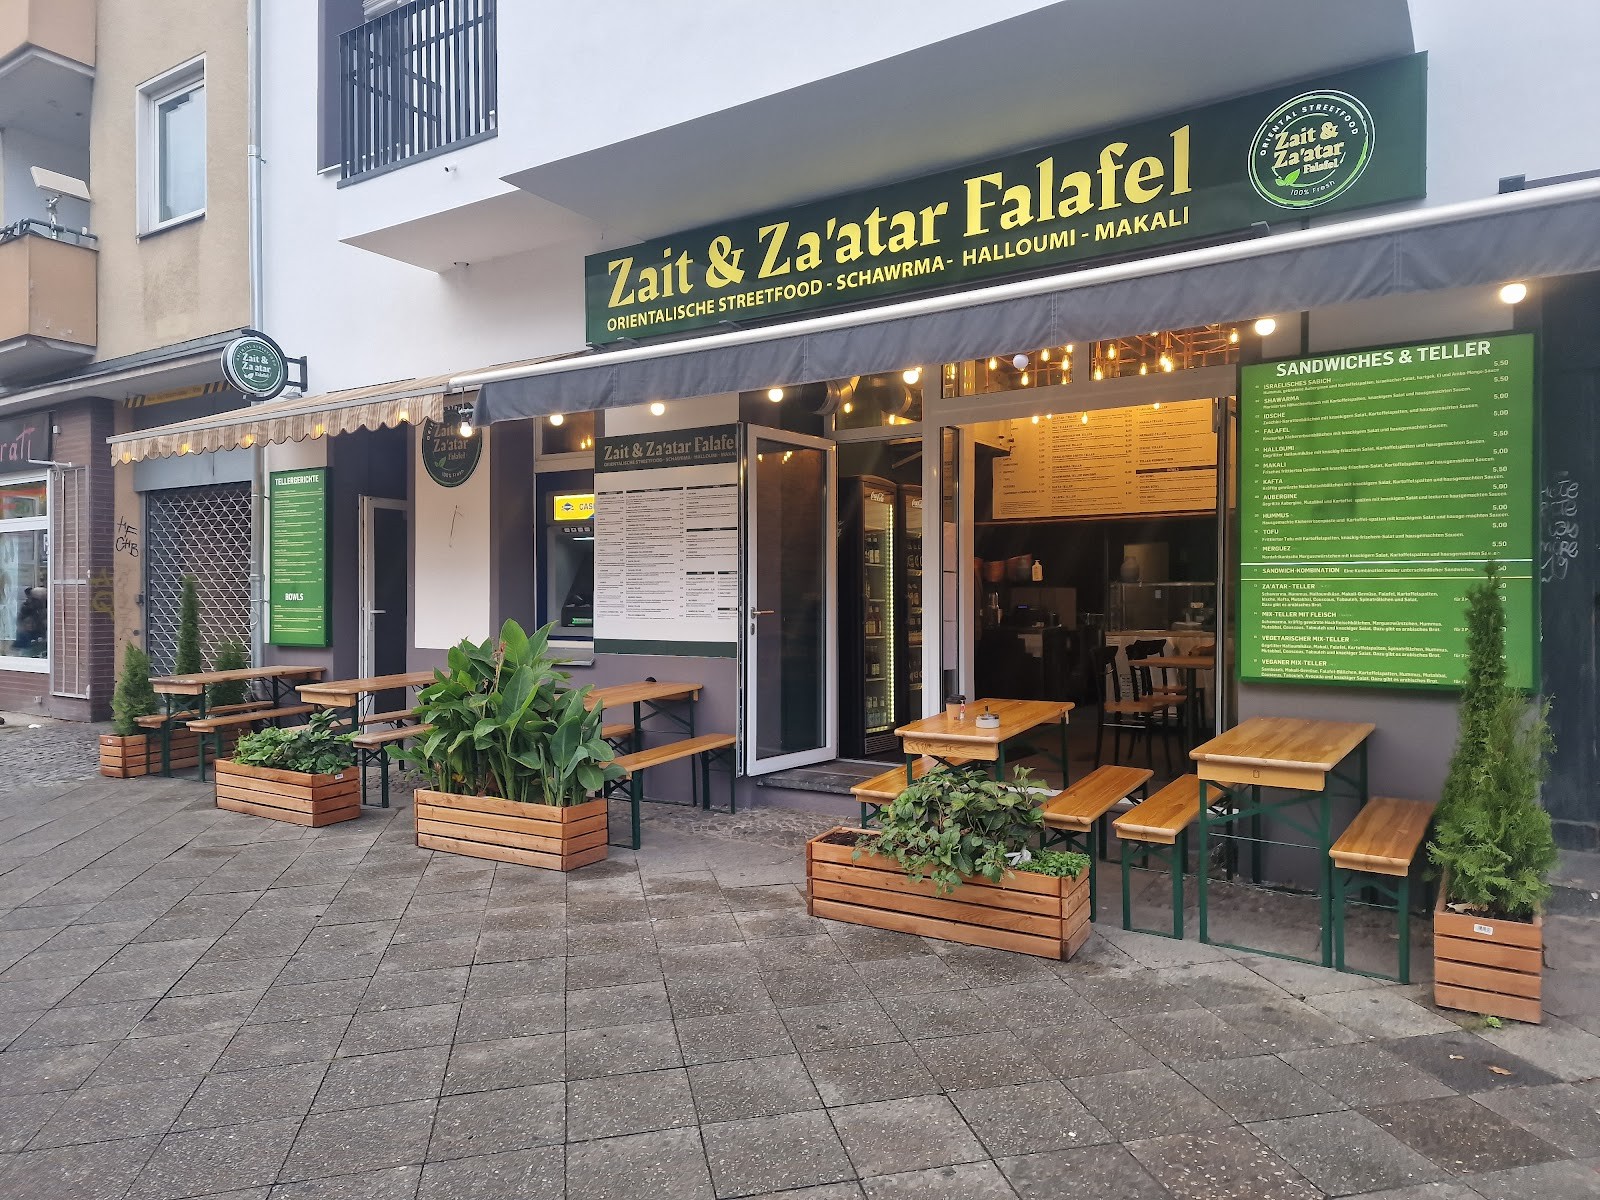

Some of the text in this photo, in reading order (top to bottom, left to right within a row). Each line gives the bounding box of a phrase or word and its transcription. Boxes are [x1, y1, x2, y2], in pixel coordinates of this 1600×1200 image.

[1260, 104, 1359, 156] ORIENTAL STREETFOOD
[1275, 122, 1338, 150] Zait &
[1272, 142, 1345, 168] Za'atar
[1303, 158, 1339, 174] Falafel
[1312, 180, 1336, 193] Fresh
[608, 124, 1192, 308] Zait & Za'atar Falafel
[607, 299, 715, 332] ORIENTALISCHE
[719, 279, 823, 312] STREETFOOD
[963, 229, 1075, 266] HALLOUMI
[1094, 206, 1189, 241] MAKALI
[242, 352, 269, 365] Zait &
[1276, 341, 1491, 377] SANDWICHES & TELLER
[1264, 396, 1300, 404] SHAWARMA
[433, 438, 468, 452] Za'atar
[604, 444, 629, 460] Zait
[632, 443, 643, 458] &
[646, 440, 691, 457] Za'atar
[448, 452, 466, 460] Falafel
[275, 475, 319, 486] TELLERGERICHTE
[285, 593, 304, 601] BOWLS
